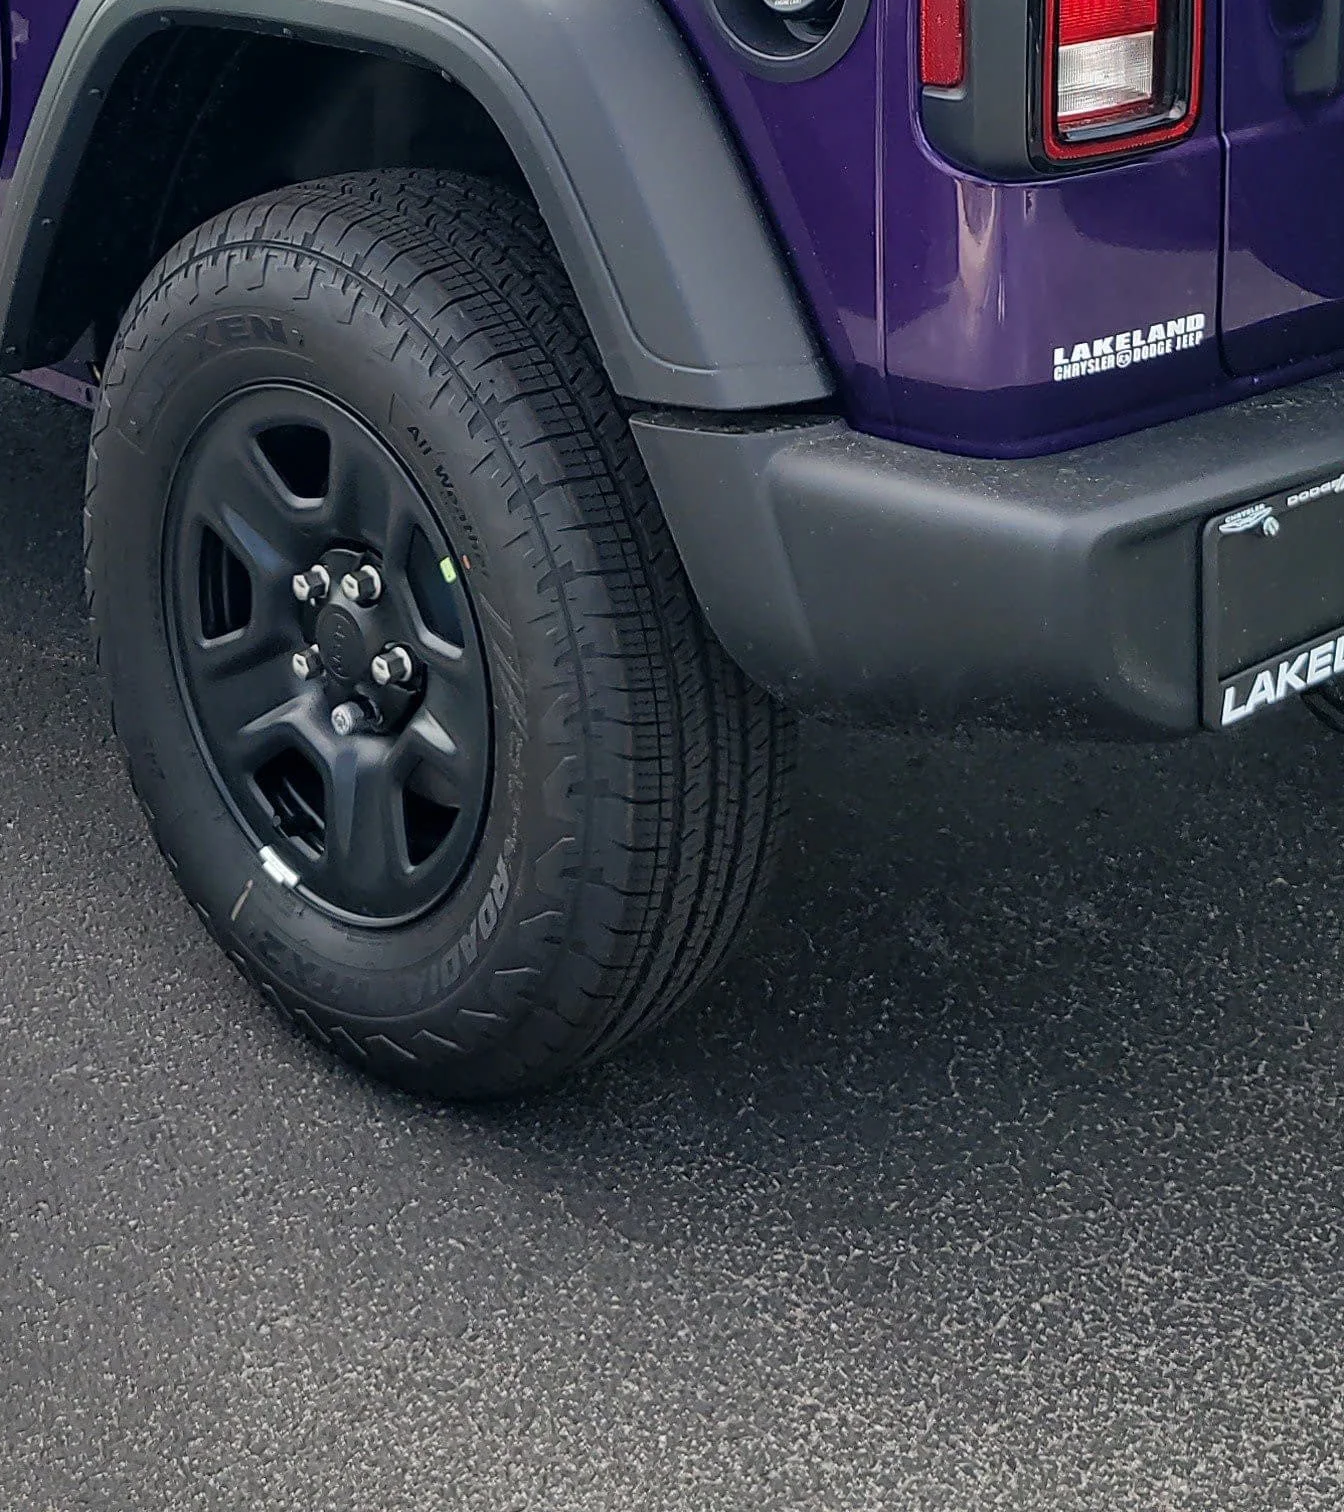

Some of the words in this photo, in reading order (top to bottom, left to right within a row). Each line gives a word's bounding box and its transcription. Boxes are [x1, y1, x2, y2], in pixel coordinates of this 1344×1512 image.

[1053, 313, 1205, 366] LAKELAND
[1053, 354, 1117, 381] CHRYSLER
[1132, 338, 1172, 362] DODGE
[1175, 330, 1204, 351] JEEP
